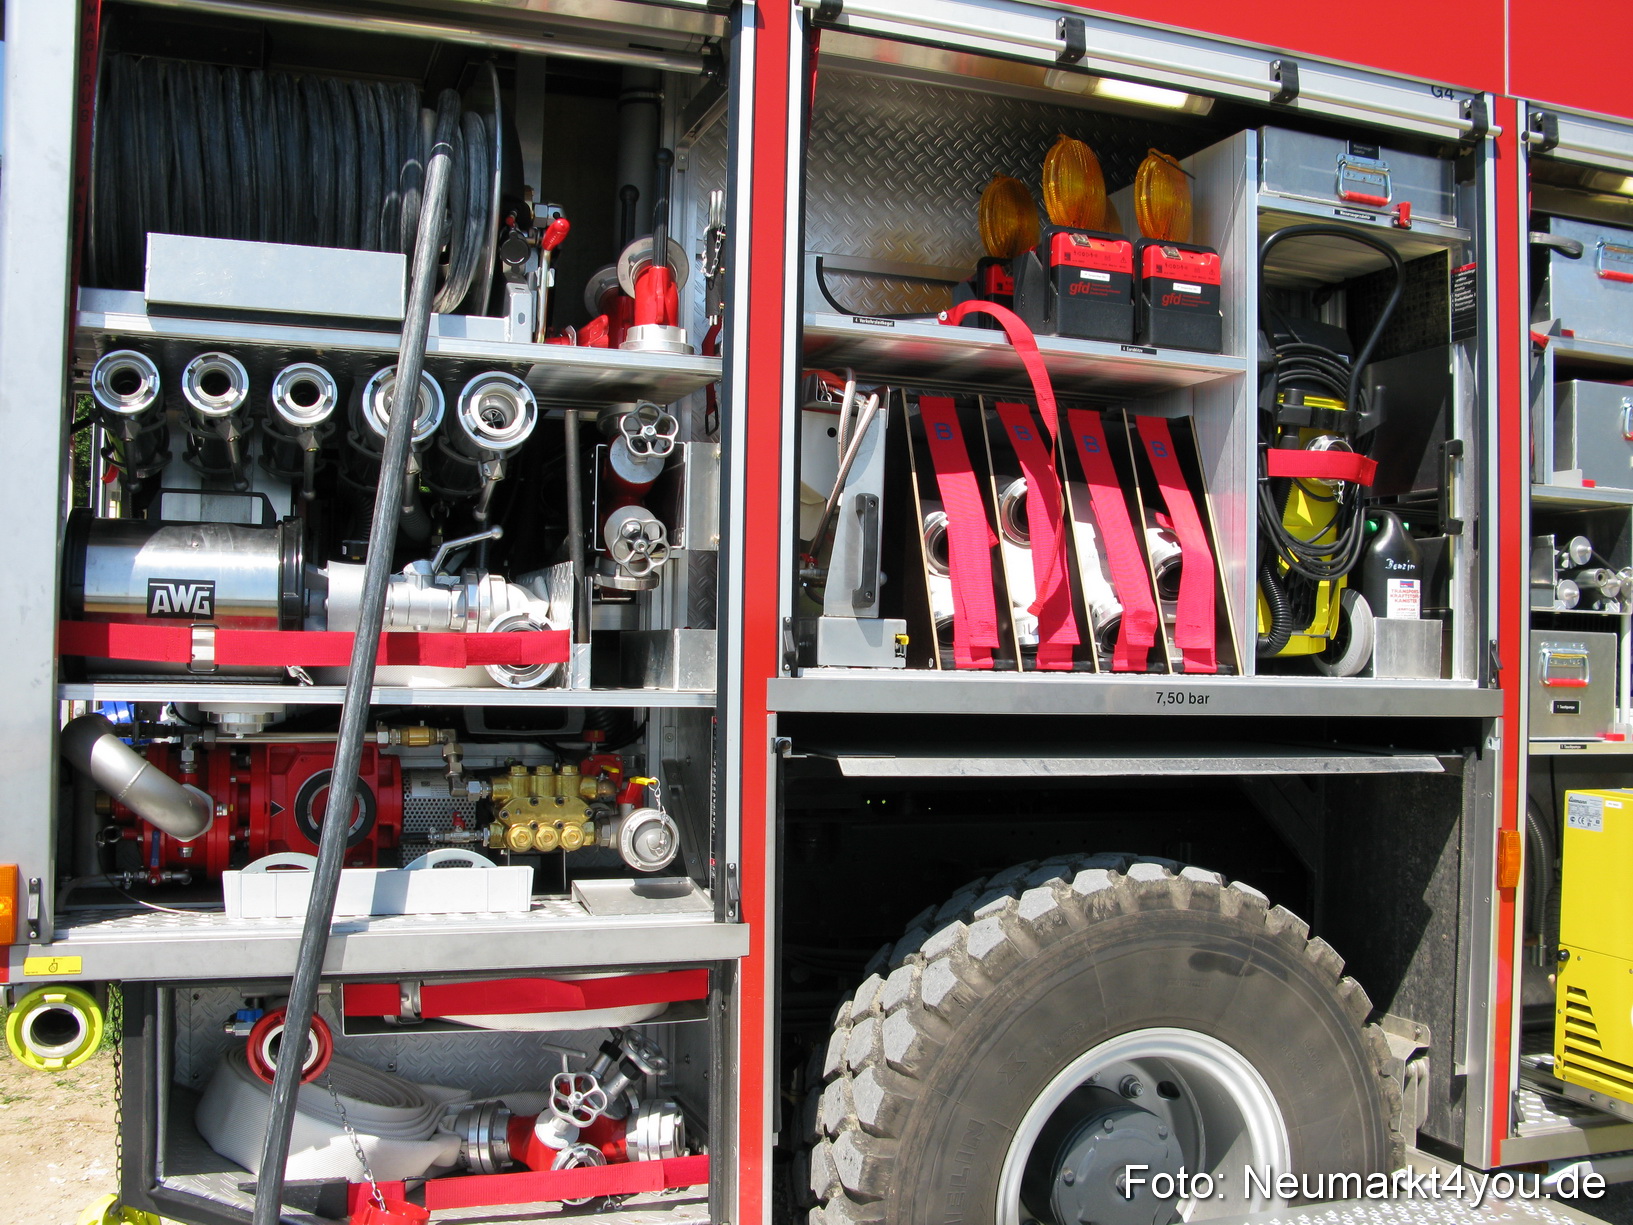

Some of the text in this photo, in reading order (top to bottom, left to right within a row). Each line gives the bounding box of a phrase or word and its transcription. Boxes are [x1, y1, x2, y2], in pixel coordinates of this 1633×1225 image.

[80, 3, 97, 123] MAGIRUS
[1431, 85, 1454, 101] G4
[1069, 281, 1091, 296] gfd
[1161, 292, 1183, 307] gfd
[934, 422, 954, 441] B
[1013, 425, 1033, 441] B
[1082, 435, 1101, 453] B
[1150, 440, 1168, 458] B
[1385, 558, 1416, 571] Benzin
[149, 582, 214, 616] AWG
[1156, 692, 1210, 706] 7,50 bar
